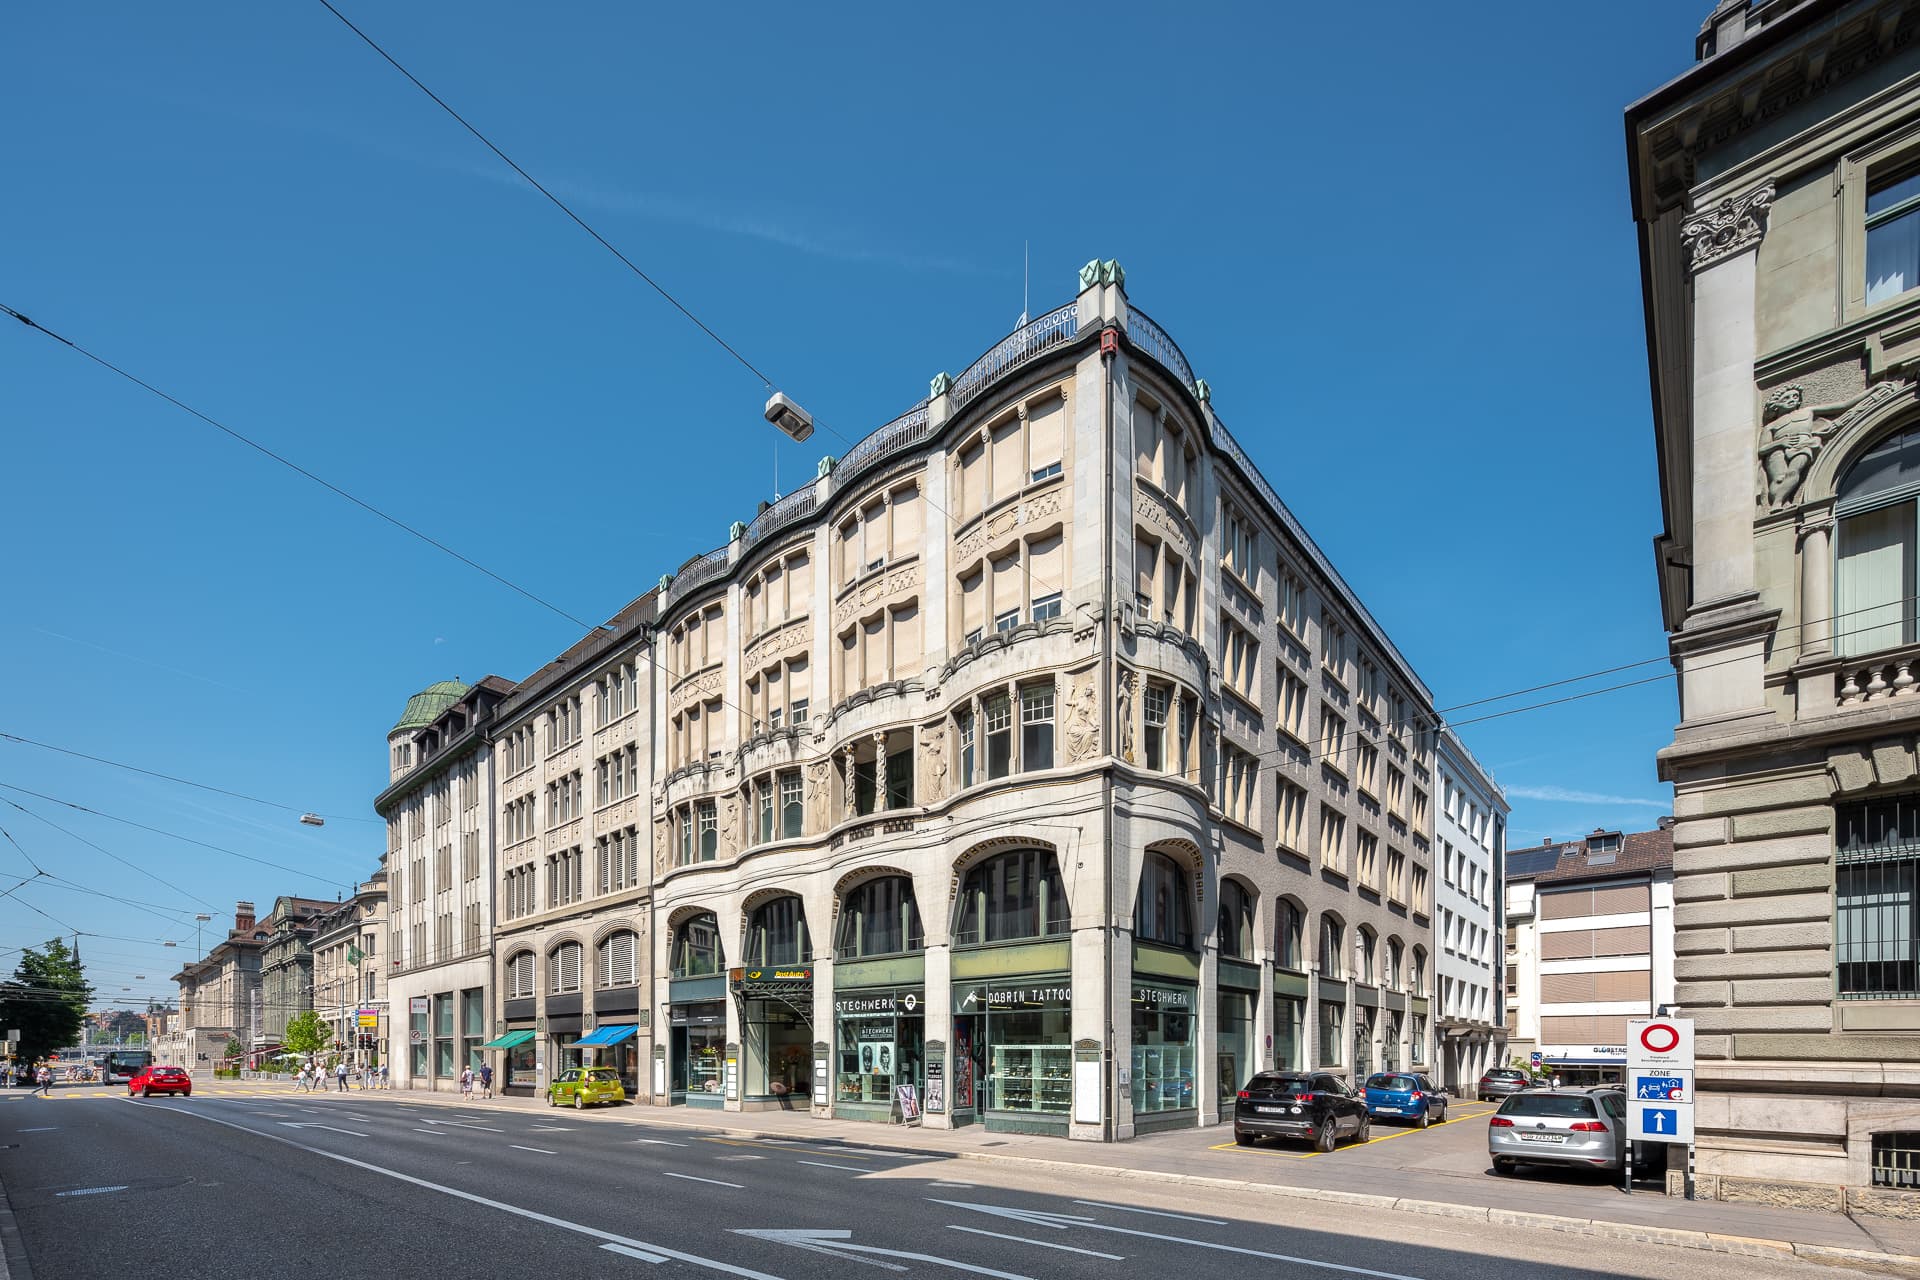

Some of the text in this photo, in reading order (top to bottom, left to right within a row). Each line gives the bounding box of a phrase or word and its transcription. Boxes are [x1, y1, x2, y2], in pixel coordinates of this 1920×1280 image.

[775, 970, 805, 978] PostAuto
[988, 988, 1071, 1004] DOBRIN TATTOO
[1140, 989, 1188, 1005] STECHWERK
[835, 998, 895, 1012] STECHWERK
